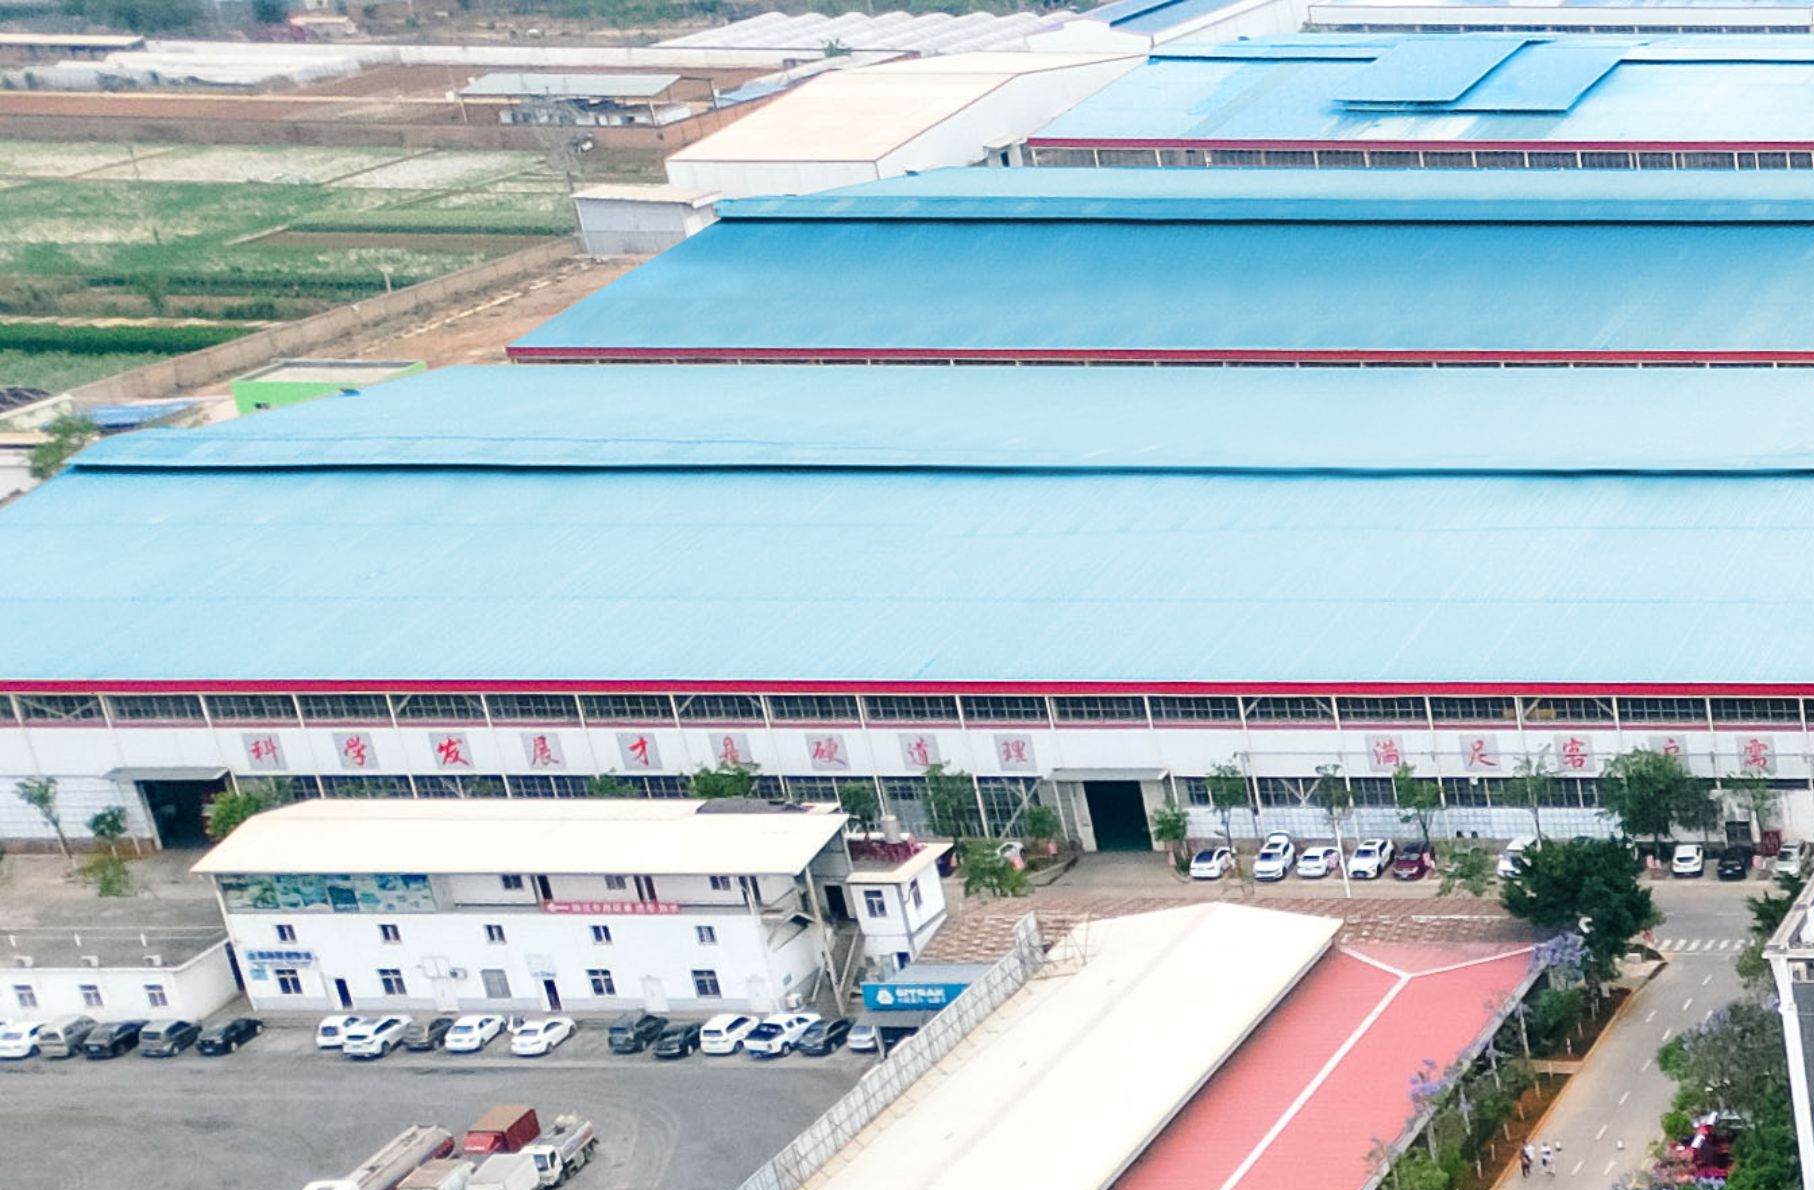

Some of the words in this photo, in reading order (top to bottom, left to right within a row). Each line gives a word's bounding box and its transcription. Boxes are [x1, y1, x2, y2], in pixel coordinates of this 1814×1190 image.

[250, 734, 1029, 767] 科学发展才是硬道理
